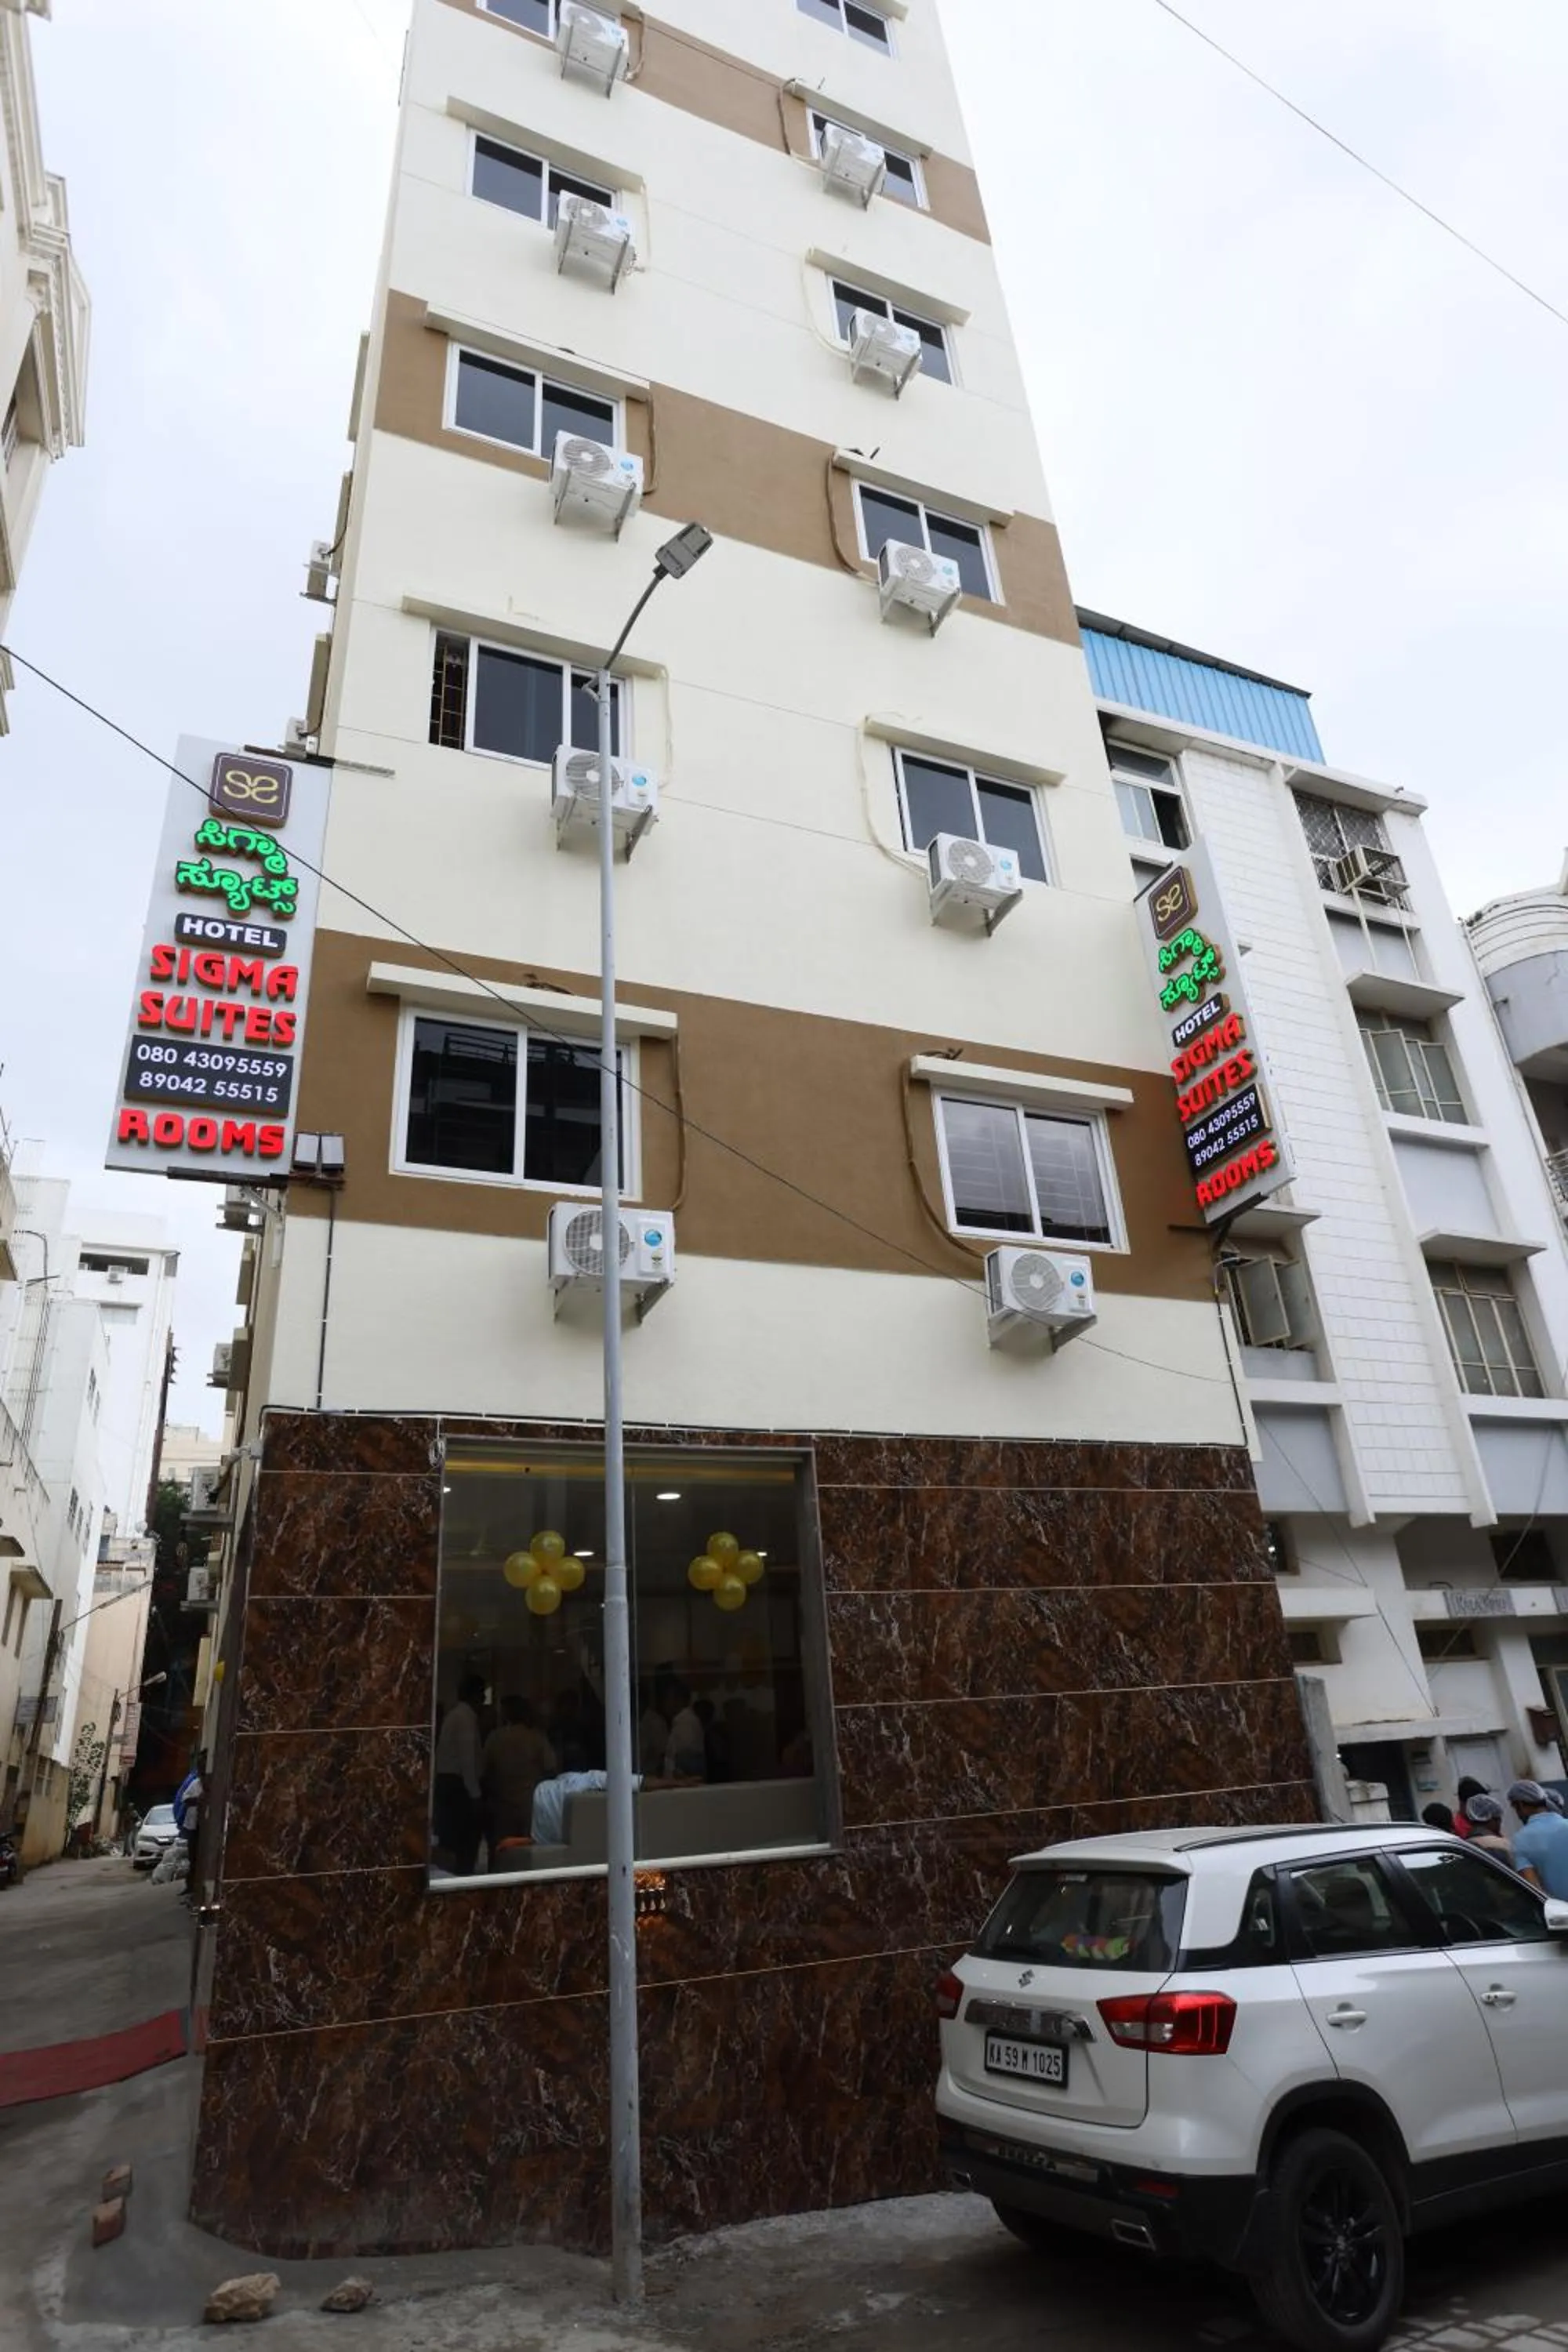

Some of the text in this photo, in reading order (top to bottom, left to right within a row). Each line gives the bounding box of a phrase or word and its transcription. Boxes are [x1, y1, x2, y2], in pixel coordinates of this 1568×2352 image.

[183, 916, 278, 947] HOTEL
[150, 944, 299, 1001] SIGMA
[138, 990, 297, 1047] SUITES
[1175, 1000, 1221, 1044] HOTEL
[136, 1044, 287, 1078] 080 43095559
[1171, 1012, 1243, 1084] SIGMA
[139, 1071, 278, 1103] 89042 55515
[1178, 1048, 1254, 1122] SUITES
[118, 1108, 285, 1157] ROOMS
[1187, 1092, 1256, 1149] 080 43095559
[1194, 1113, 1259, 1167] 89042 55515
[1196, 1139, 1276, 1209] ROOMS
[989, 2043, 1001, 2064] KA
[1004, 2045, 1018, 2067] 59
[1033, 2051, 1061, 2077] 1025
